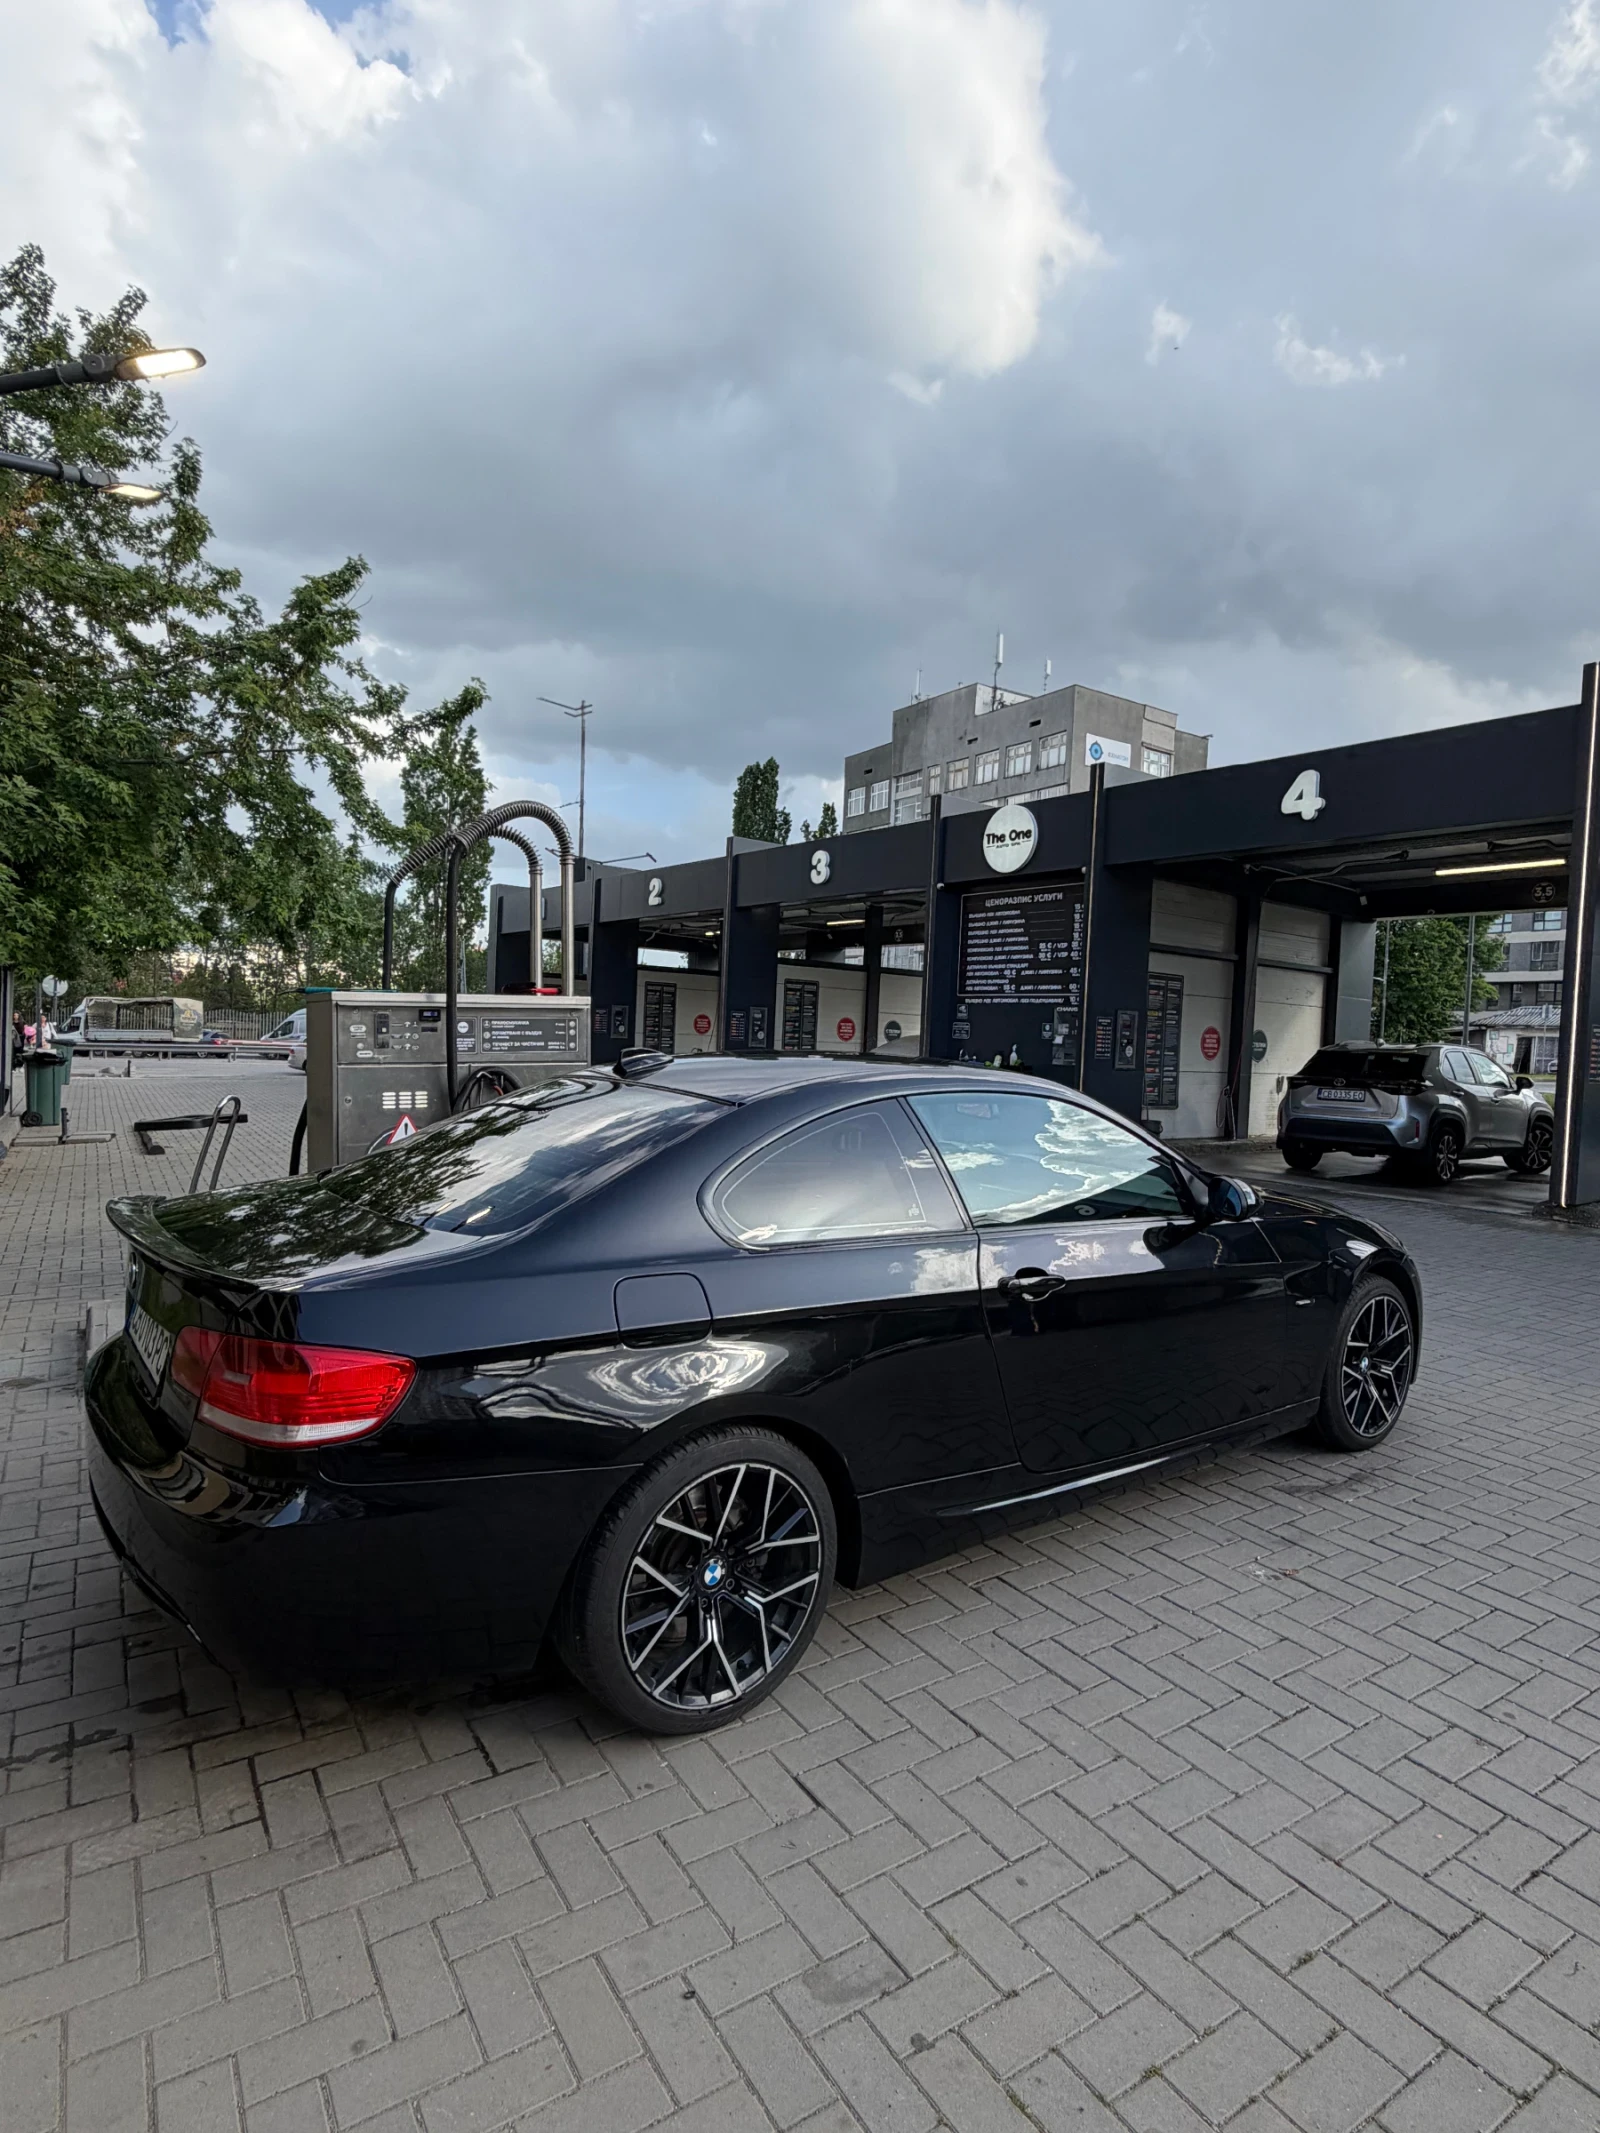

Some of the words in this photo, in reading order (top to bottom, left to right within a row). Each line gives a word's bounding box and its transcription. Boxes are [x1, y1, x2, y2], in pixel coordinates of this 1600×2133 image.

[1281, 769, 1325, 820] 4
[986, 833, 1006, 845] The
[1009, 829, 1032, 841] One
[811, 850, 830, 884] 3
[648, 878, 662, 905] 2
[985, 895, 1032, 907] ЦЕНОРАЗПИС
[1034, 892, 1063, 902] УСЛУГИ
